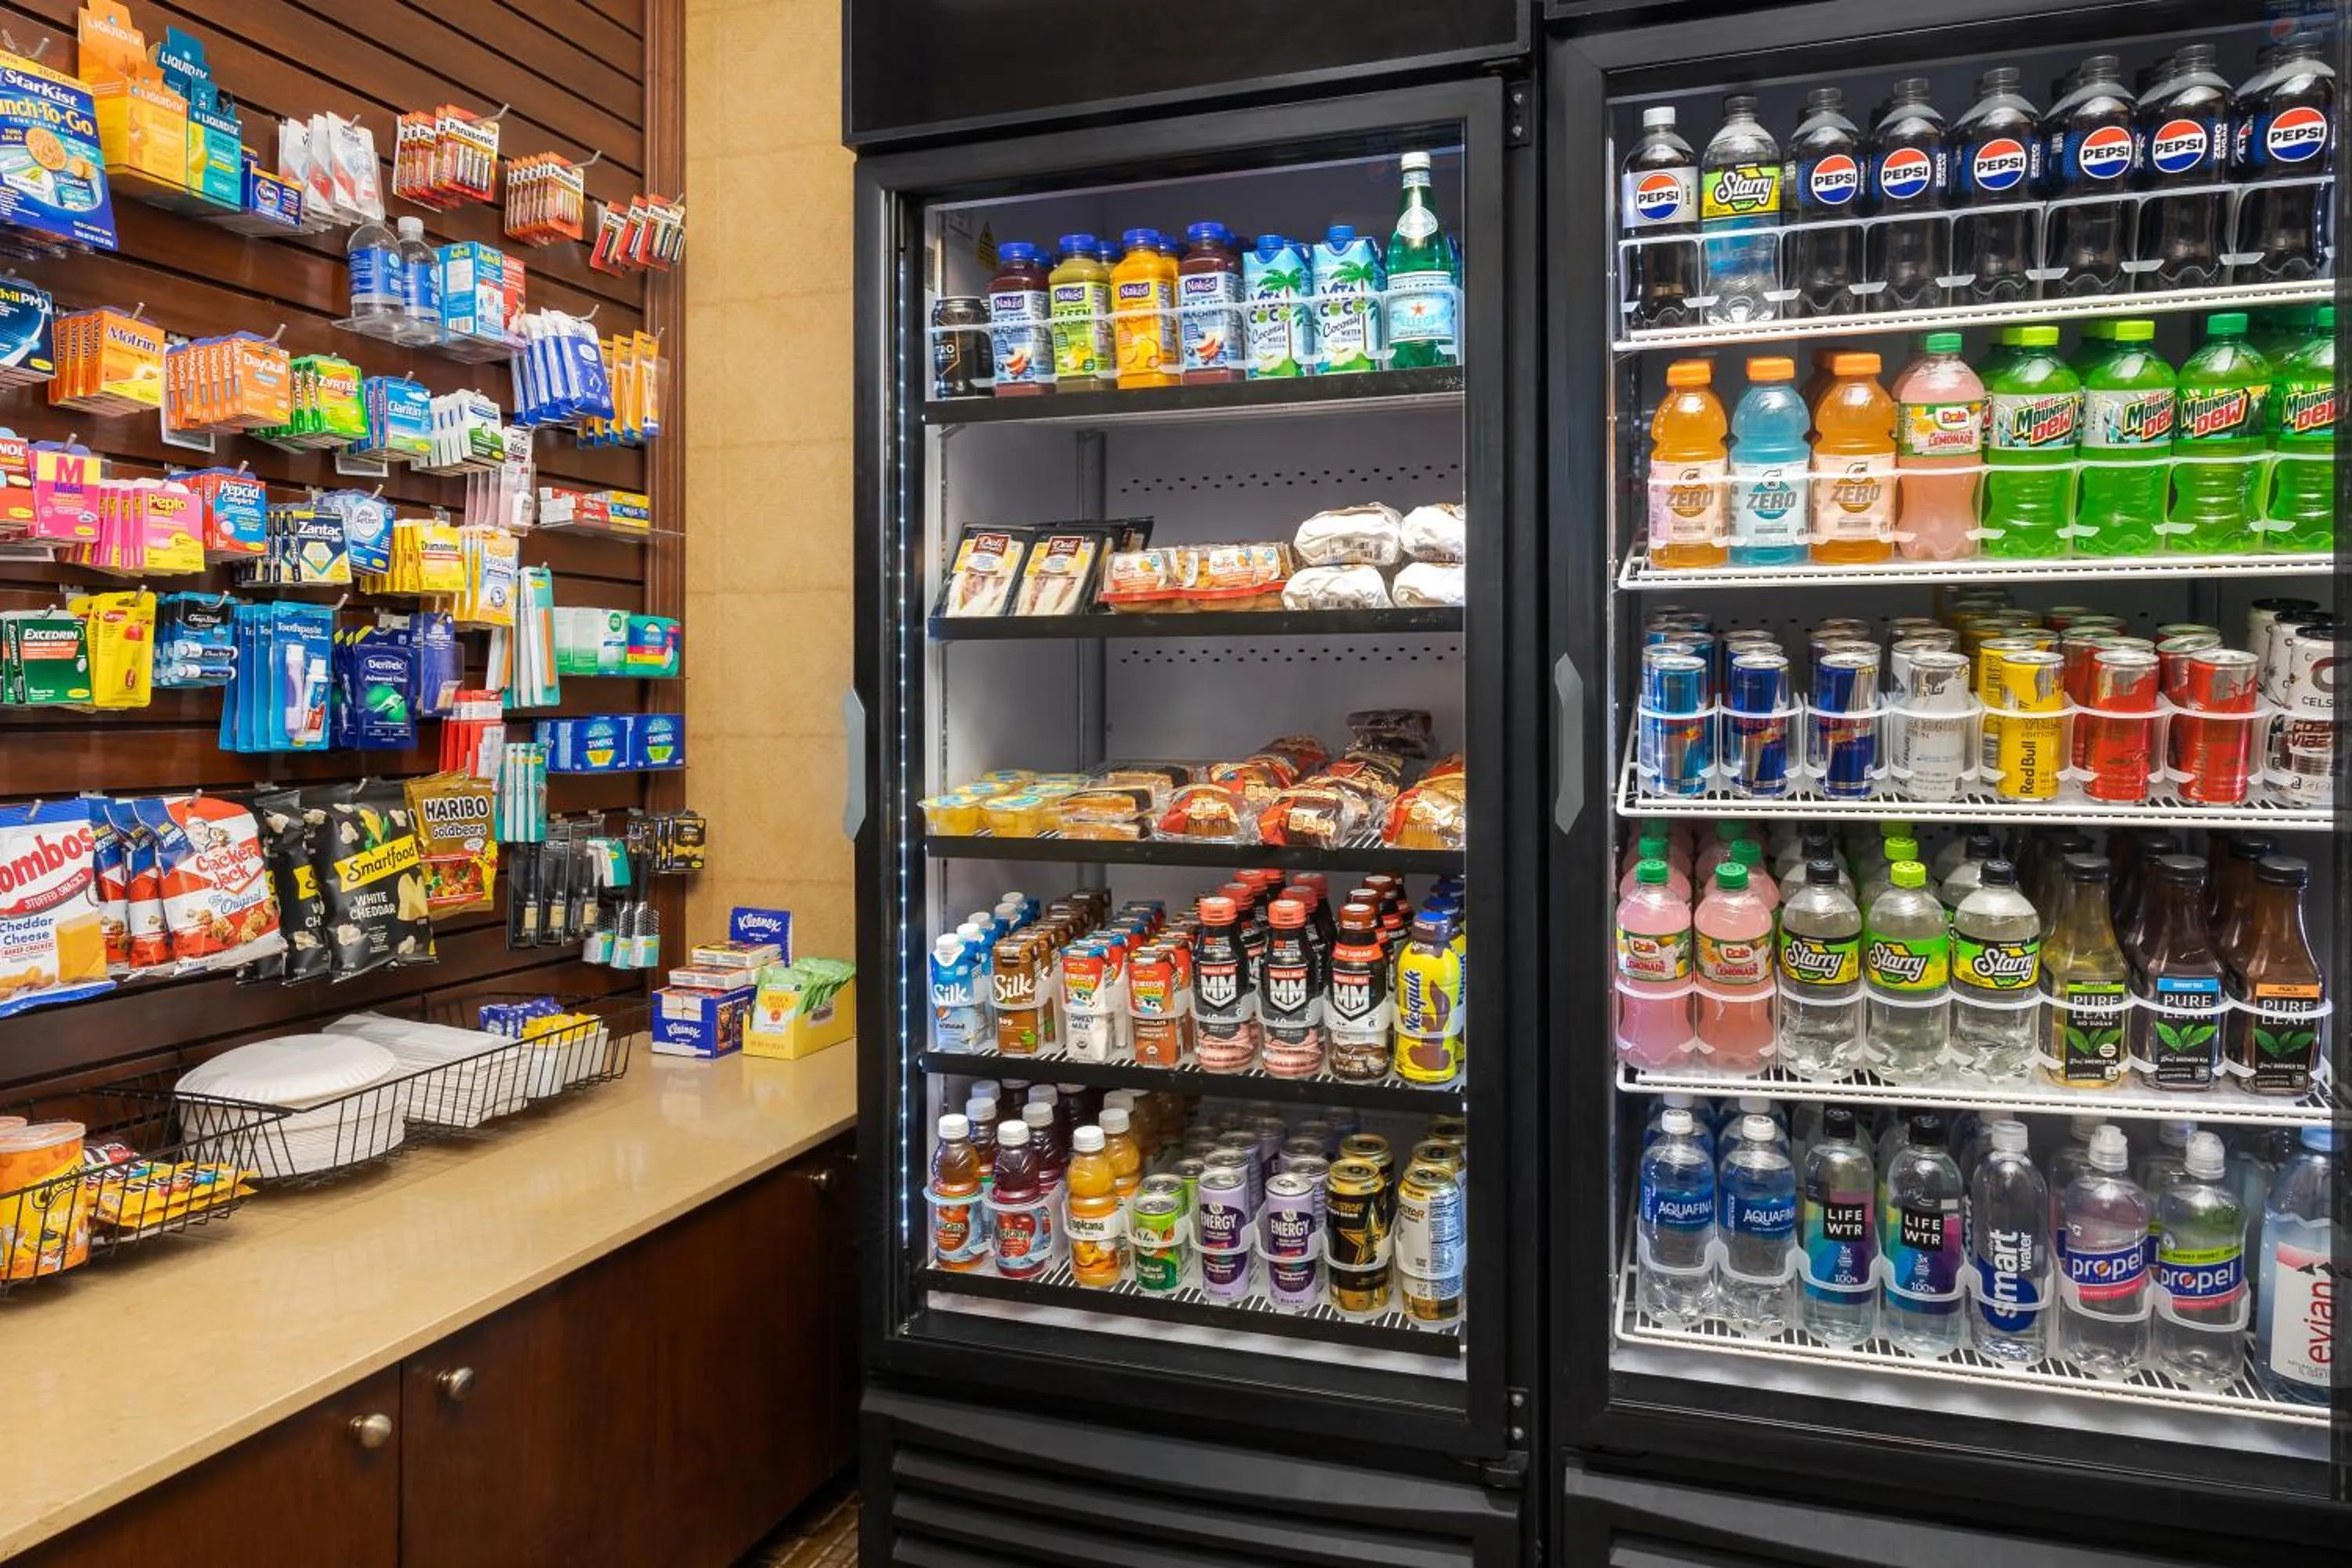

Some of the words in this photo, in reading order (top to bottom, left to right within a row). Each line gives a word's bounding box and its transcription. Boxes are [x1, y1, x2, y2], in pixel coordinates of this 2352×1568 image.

[160, 50, 196, 76] LIQUID
[5, 69, 78, 107] StarKist
[201, 114, 228, 131] LIQUID
[449, 121, 495, 147] Panasonic
[2270, 126, 2324, 143] PEPSI
[2083, 144, 2130, 161] PEPSI
[2154, 137, 2204, 155] PEPSI
[1883, 165, 1929, 181] PEPSI
[1976, 157, 2024, 173] PEPSI
[1715, 172, 1773, 204] Starry
[1814, 173, 1856, 187] PEPSI
[1639, 190, 1679, 204] PEPSI
[1120, 285, 1149, 298] Naked
[1185, 278, 1216, 292] Naked
[1056, 288, 1083, 301] Naked
[996, 297, 1023, 310] Naked
[107, 325, 158, 353] Motrin
[243, 353, 286, 375] DayQuil
[388, 401, 422, 417] Claritin
[2034, 397, 2055, 408] DIET
[1942, 410, 1966, 423] Dole
[1929, 433, 1974, 447] LEMONADE
[220, 481, 260, 499] Pepcid
[1665, 489, 1715, 507] ZERO
[1831, 484, 1882, 503] ZERO
[147, 493, 188, 511] Pepto
[1747, 492, 1797, 510] ZERO
[298, 521, 341, 537] Zantac
[24, 628, 79, 641] EXCEDRIN
[277, 622, 323, 636] Toothpaste
[2301, 695, 2333, 707] CELS
[425, 797, 488, 821] HARIBO
[432, 824, 486, 838] Goldbears
[0, 827, 95, 895] ombos
[195, 842, 256, 872] Cracker
[347, 844, 415, 883] Smartfood
[213, 864, 250, 889] Jack
[354, 891, 387, 906] WHITE
[350, 902, 396, 920] CHEDDAR
[0, 916, 54, 933] Cheddar
[738, 914, 782, 933] Kleenex
[4, 931, 49, 946] Cheese
[1633, 940, 1657, 953] Dole
[1726, 946, 1751, 958] Dole
[1786, 941, 1842, 978] Starry
[1715, 964, 1759, 976] LEMONADE
[1869, 942, 1926, 981] Starry
[1973, 948, 2035, 980] Starry
[934, 983, 970, 1003] Silk
[993, 974, 1034, 1002] Silk
[2163, 994, 2212, 1008] PURE
[2263, 1000, 2312, 1014] PURE
[666, 1022, 702, 1039] Kleenex
[1200, 1214, 1237, 1230] ENERGY
[1828, 1209, 1863, 1221] LIFE
[1904, 1214, 1942, 1231] LIFE
[1271, 1218, 1309, 1237] ENERGY
[1828, 1222, 1863, 1236] WTR
[1904, 1229, 1942, 1246] WTR
[2020, 1232, 2032, 1272] water
[2071, 1245, 2143, 1280] propel
[2160, 1262, 2234, 1294] propel
[2304, 1280, 2339, 1364] evian
